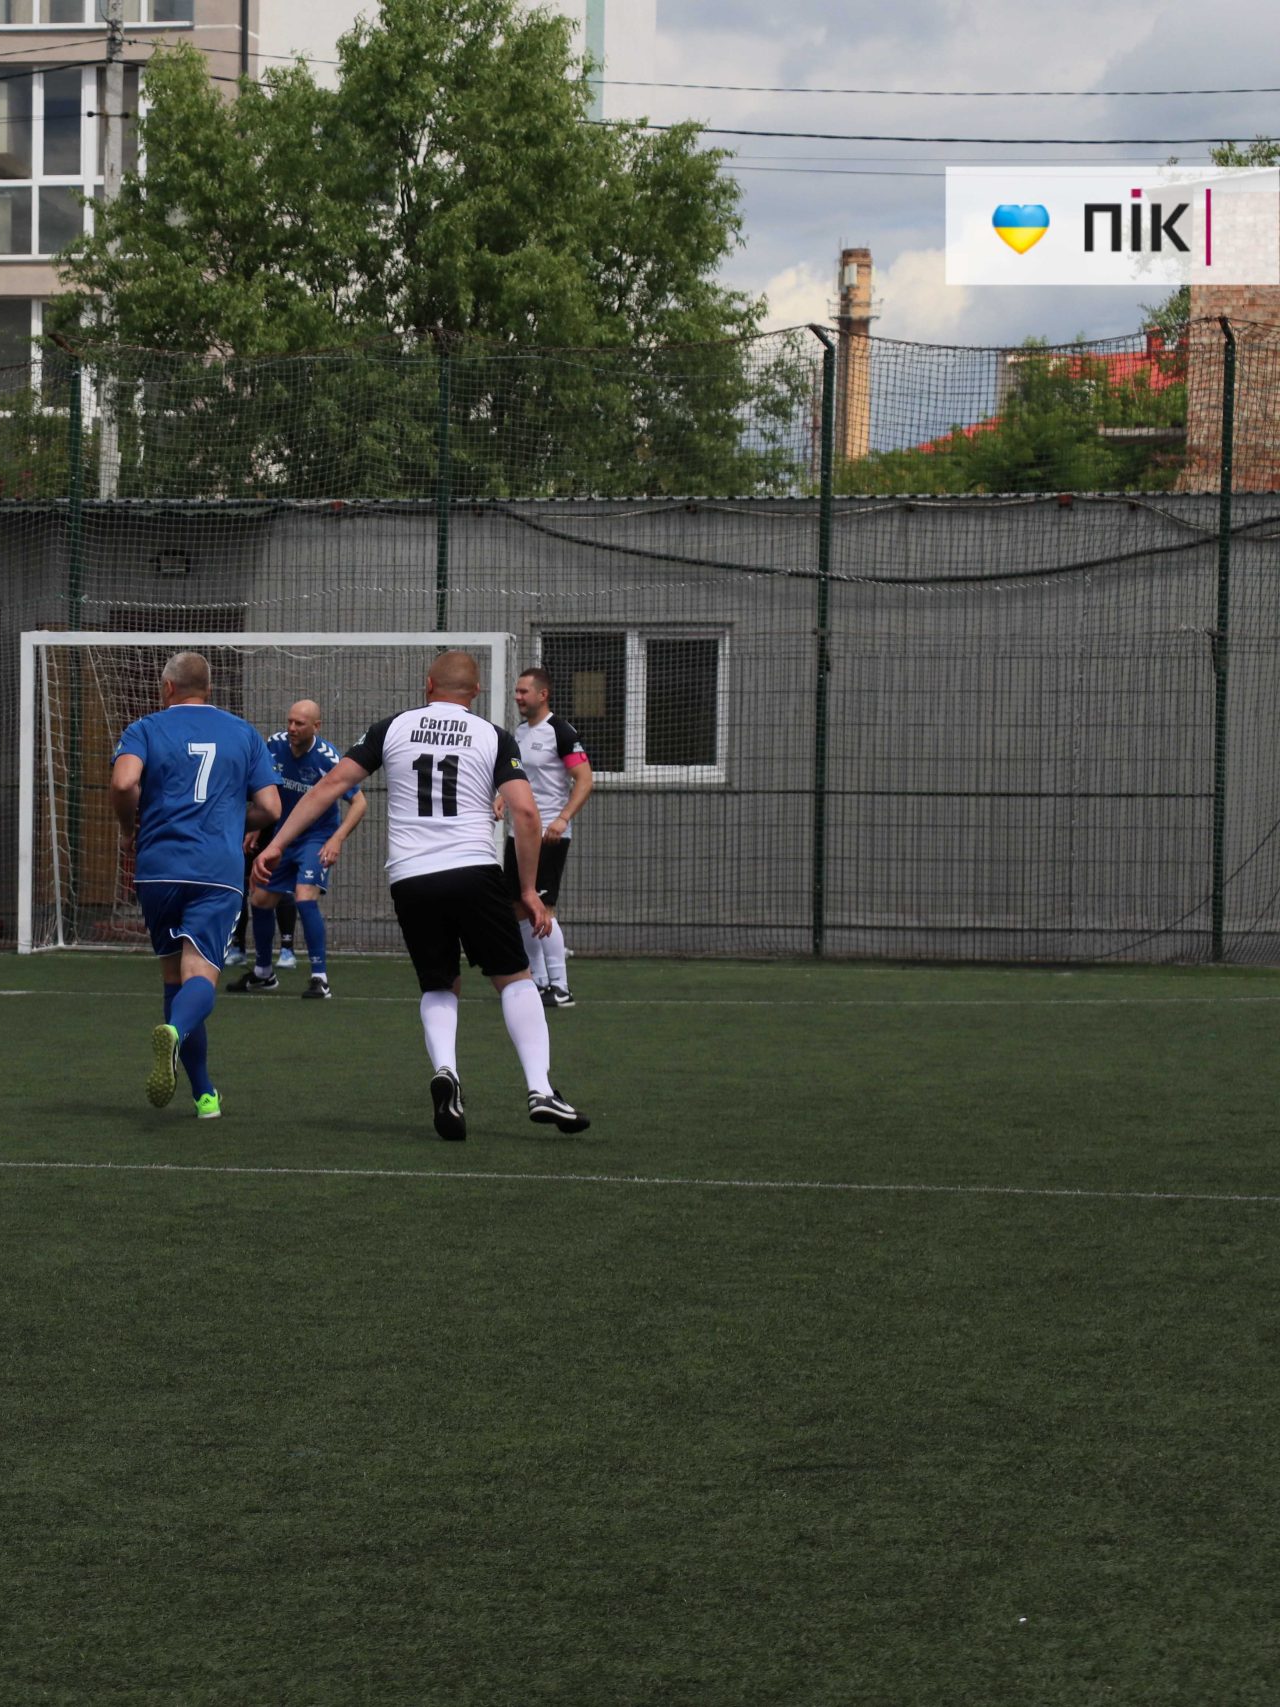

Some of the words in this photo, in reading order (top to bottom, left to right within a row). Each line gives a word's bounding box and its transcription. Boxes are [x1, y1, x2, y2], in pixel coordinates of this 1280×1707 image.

[410, 730, 472, 748] ШАХТАРЯ
[419, 716, 468, 733] СВІТЛО
[188, 742, 217, 803] 7
[412, 754, 459, 817] 11
